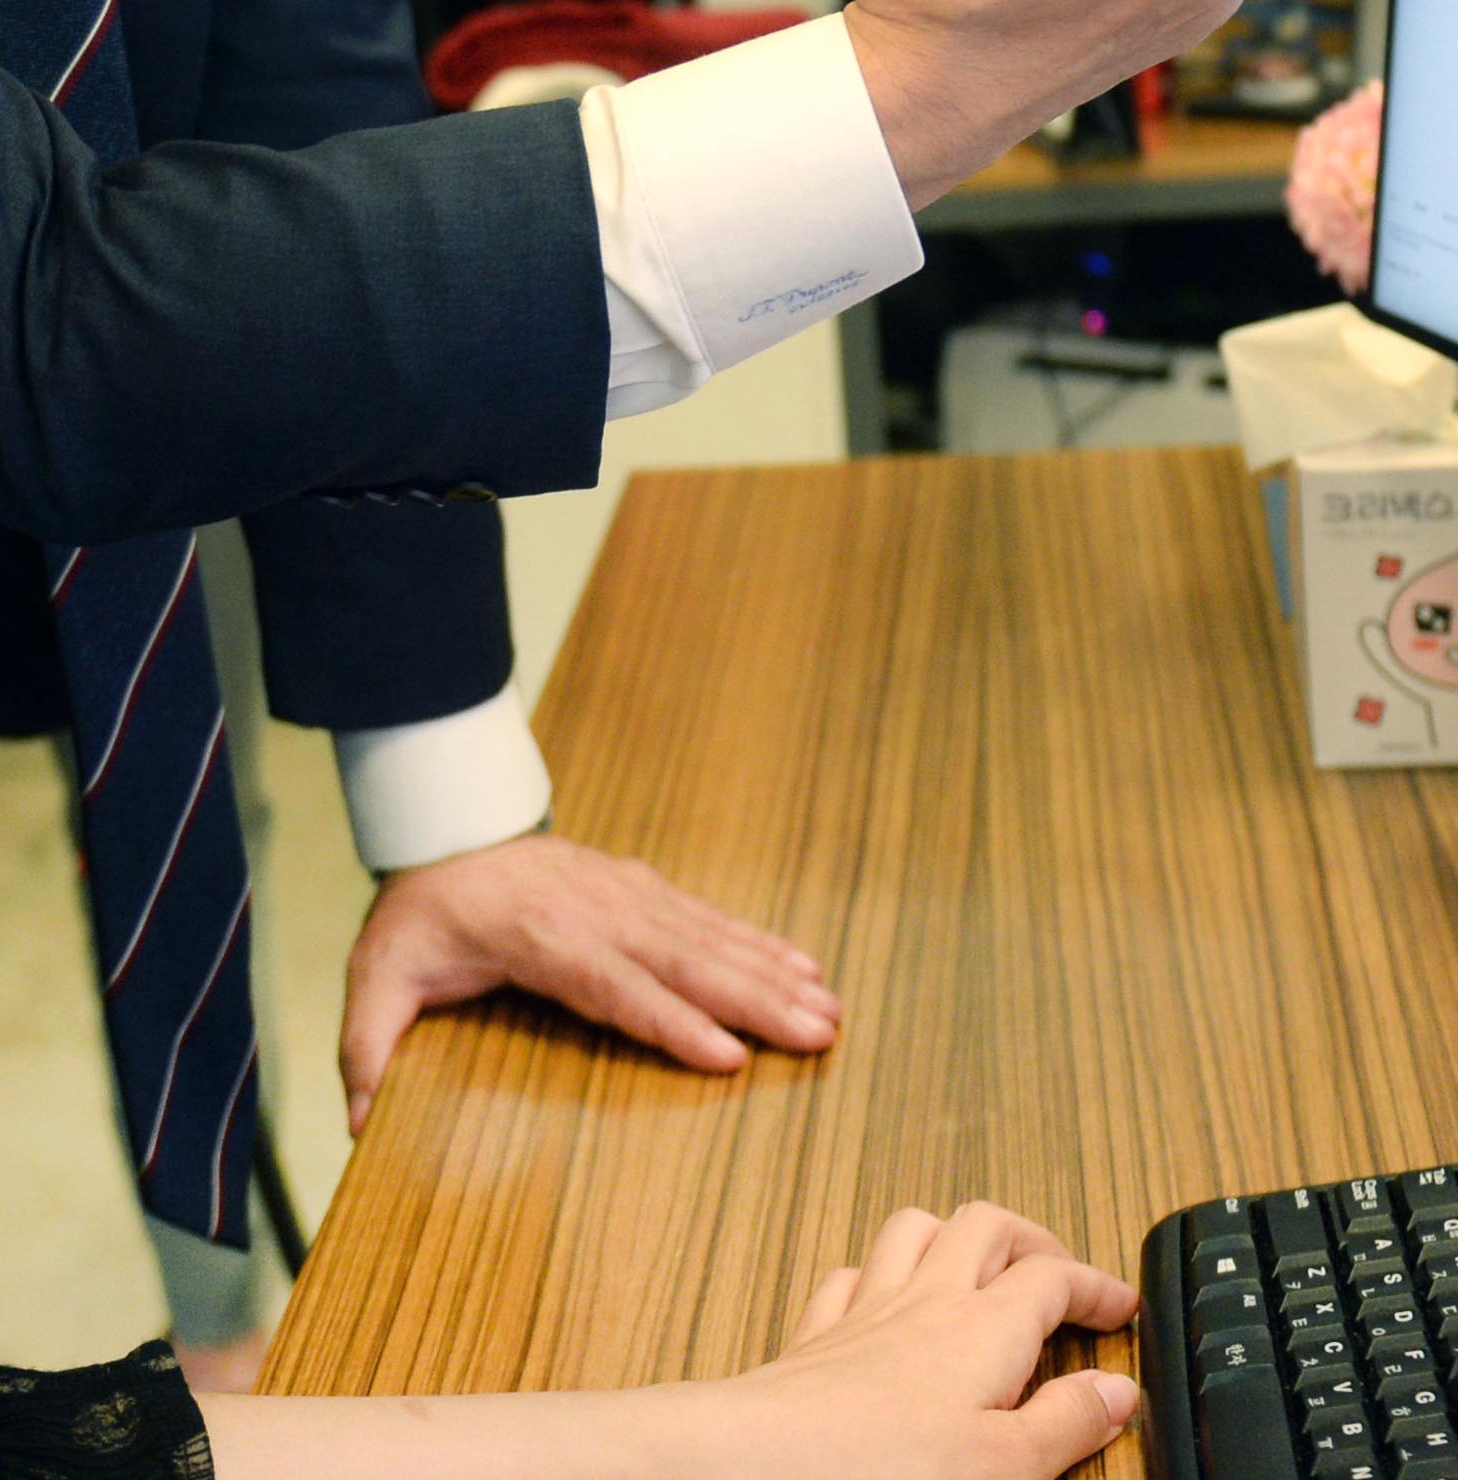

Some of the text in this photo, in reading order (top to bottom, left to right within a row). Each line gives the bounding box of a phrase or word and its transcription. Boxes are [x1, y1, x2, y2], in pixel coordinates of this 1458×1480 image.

[1374, 1239, 1393, 1250] A
[1308, 1266, 1326, 1278] Z
[1384, 1273, 1402, 1284] S
[1316, 1303, 1334, 1314] X
[1394, 1310, 1413, 1323] D
[1324, 1342, 1343, 1354] C
[1405, 1349, 1425, 1360] F
[1333, 1381, 1353, 1393] V
[1415, 1391, 1436, 1404] G
[1342, 1423, 1363, 1435] B
[1427, 1433, 1448, 1446] H
[1351, 1466, 1373, 1480] N
